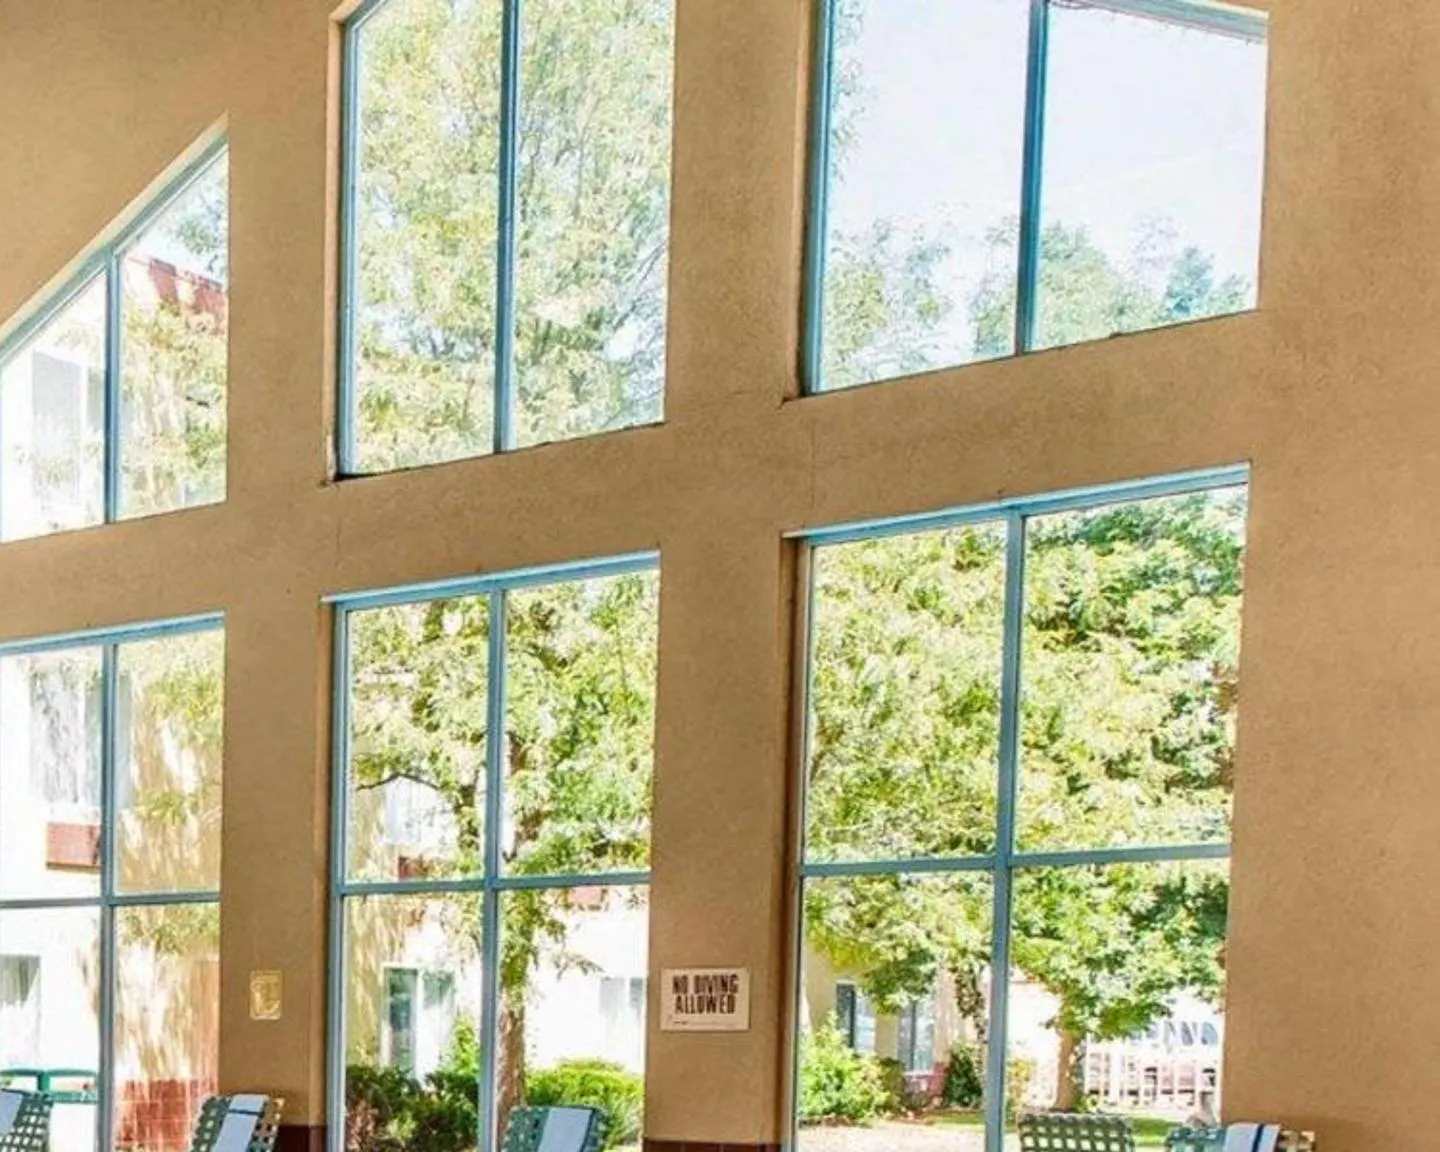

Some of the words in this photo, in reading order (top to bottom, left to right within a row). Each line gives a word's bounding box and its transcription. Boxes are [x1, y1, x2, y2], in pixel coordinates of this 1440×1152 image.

[672, 975, 688, 994] NO
[693, 974, 738, 993] DIVING
[675, 995, 736, 1014] ALLOWED
